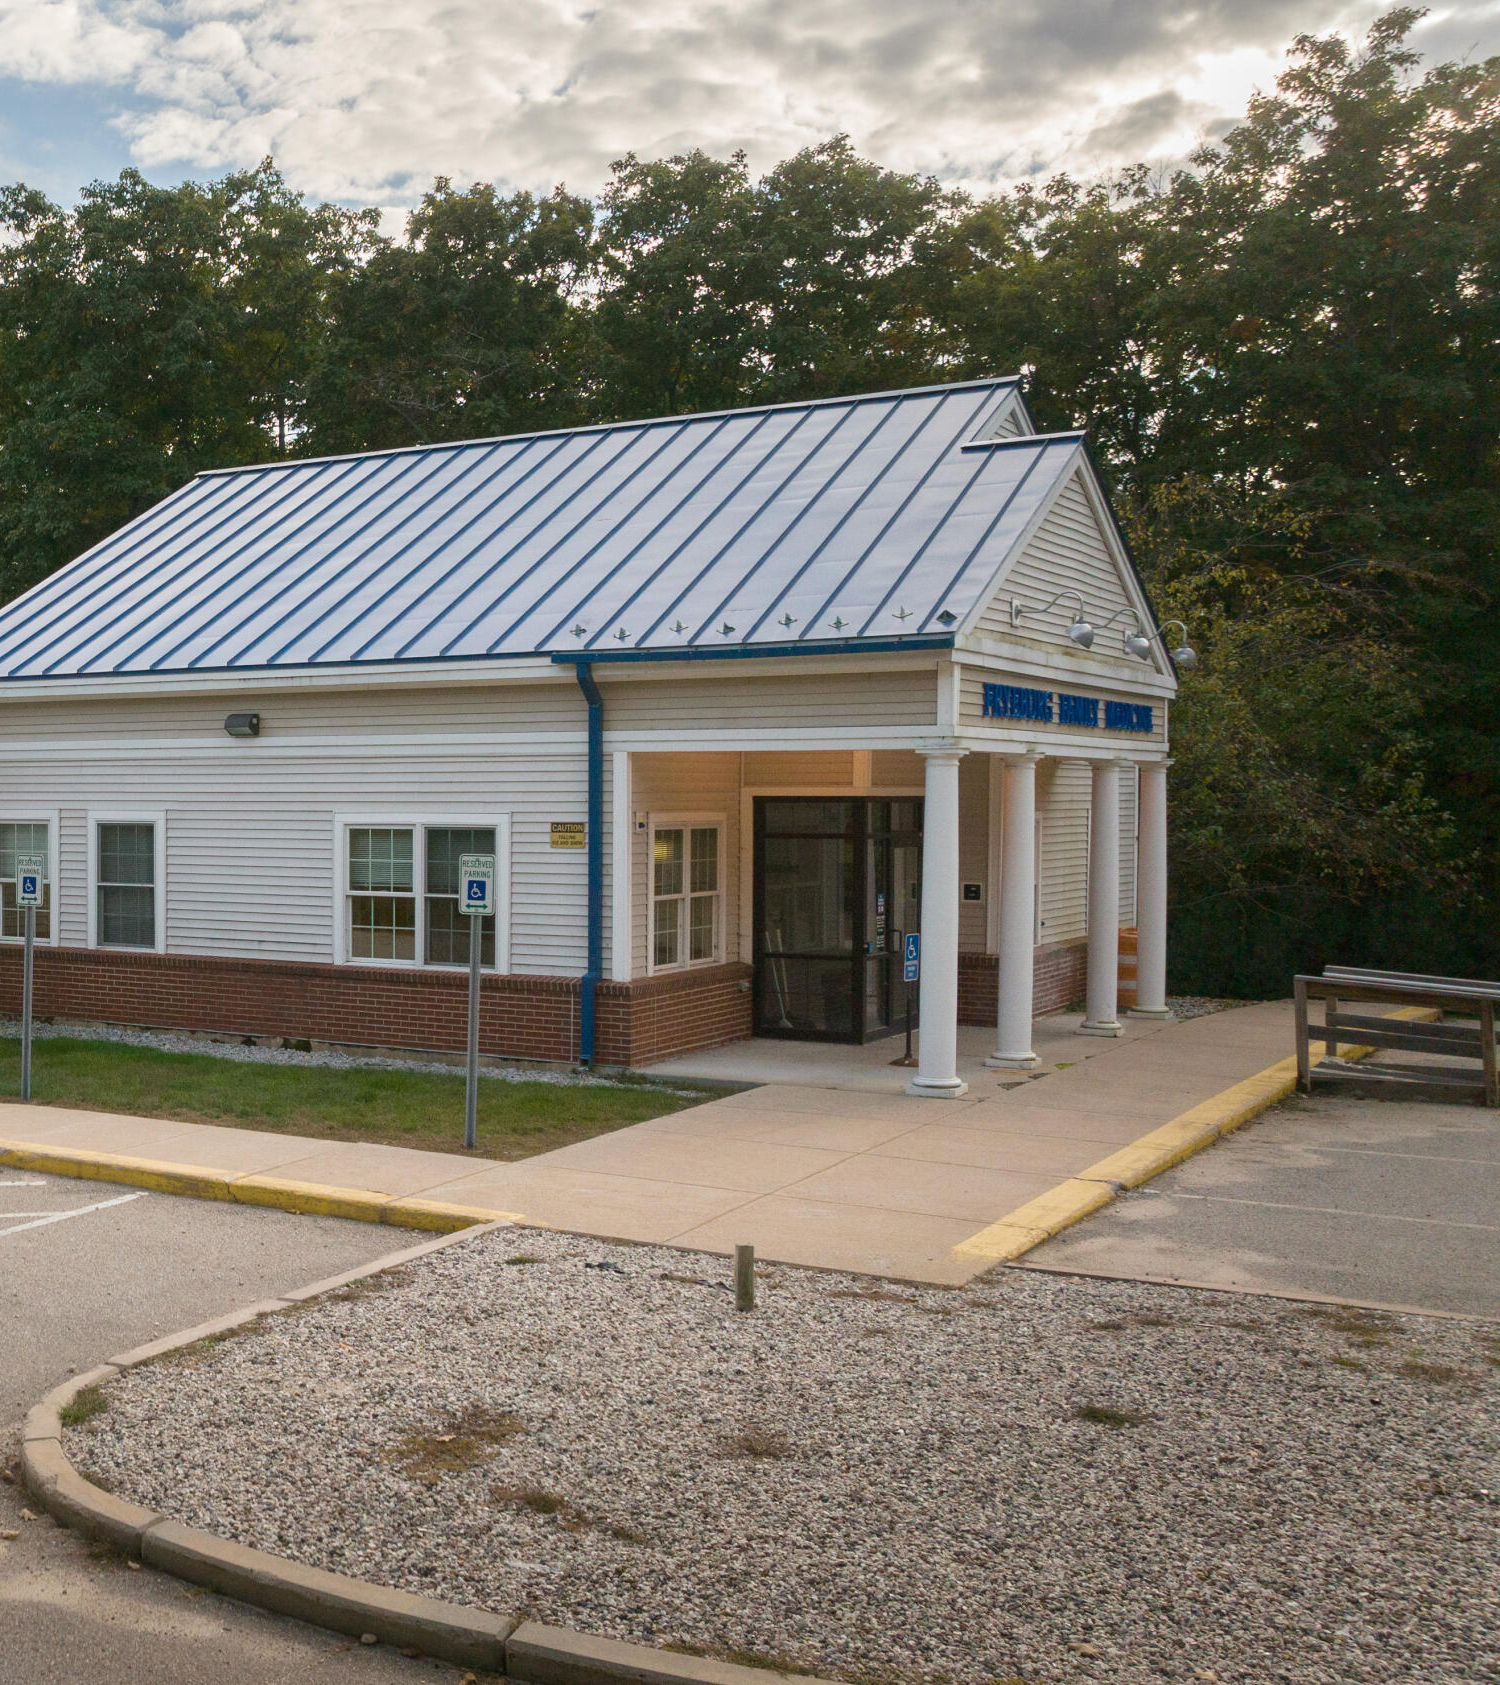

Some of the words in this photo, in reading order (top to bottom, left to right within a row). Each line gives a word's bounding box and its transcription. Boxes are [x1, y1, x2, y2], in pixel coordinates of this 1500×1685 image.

[1058, 693, 1100, 727] FAMILY
[552, 823, 584, 832] CAUTION
[19, 859, 42, 867] RESERVED
[463, 860, 493, 868] RESERVED
[464, 870, 491, 878] PARKING
